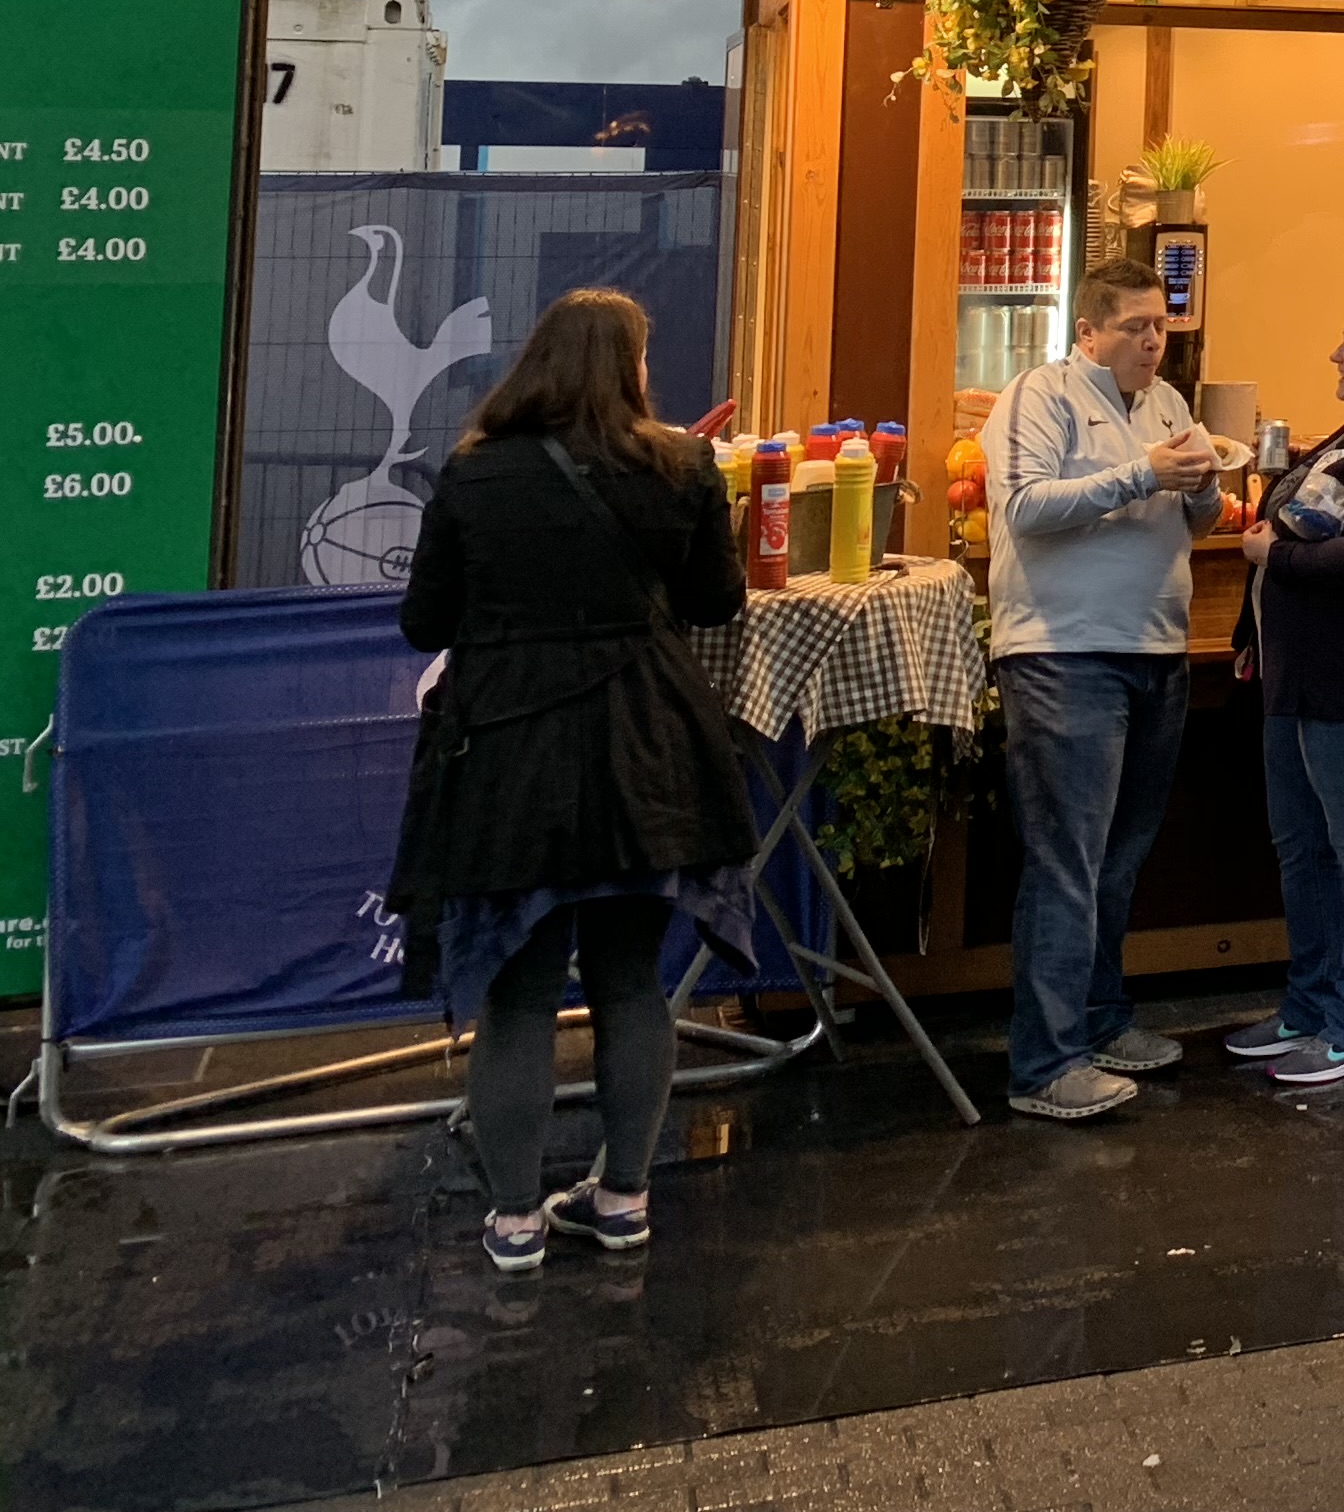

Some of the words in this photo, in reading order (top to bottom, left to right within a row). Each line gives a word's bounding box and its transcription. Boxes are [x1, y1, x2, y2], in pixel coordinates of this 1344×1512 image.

[62, 137, 150, 162] £4.50
[60, 186, 150, 210] £4.00
[57, 238, 147, 262] £4.00
[43, 472, 132, 498] £6.00
[35, 572, 124, 599] £2.00
